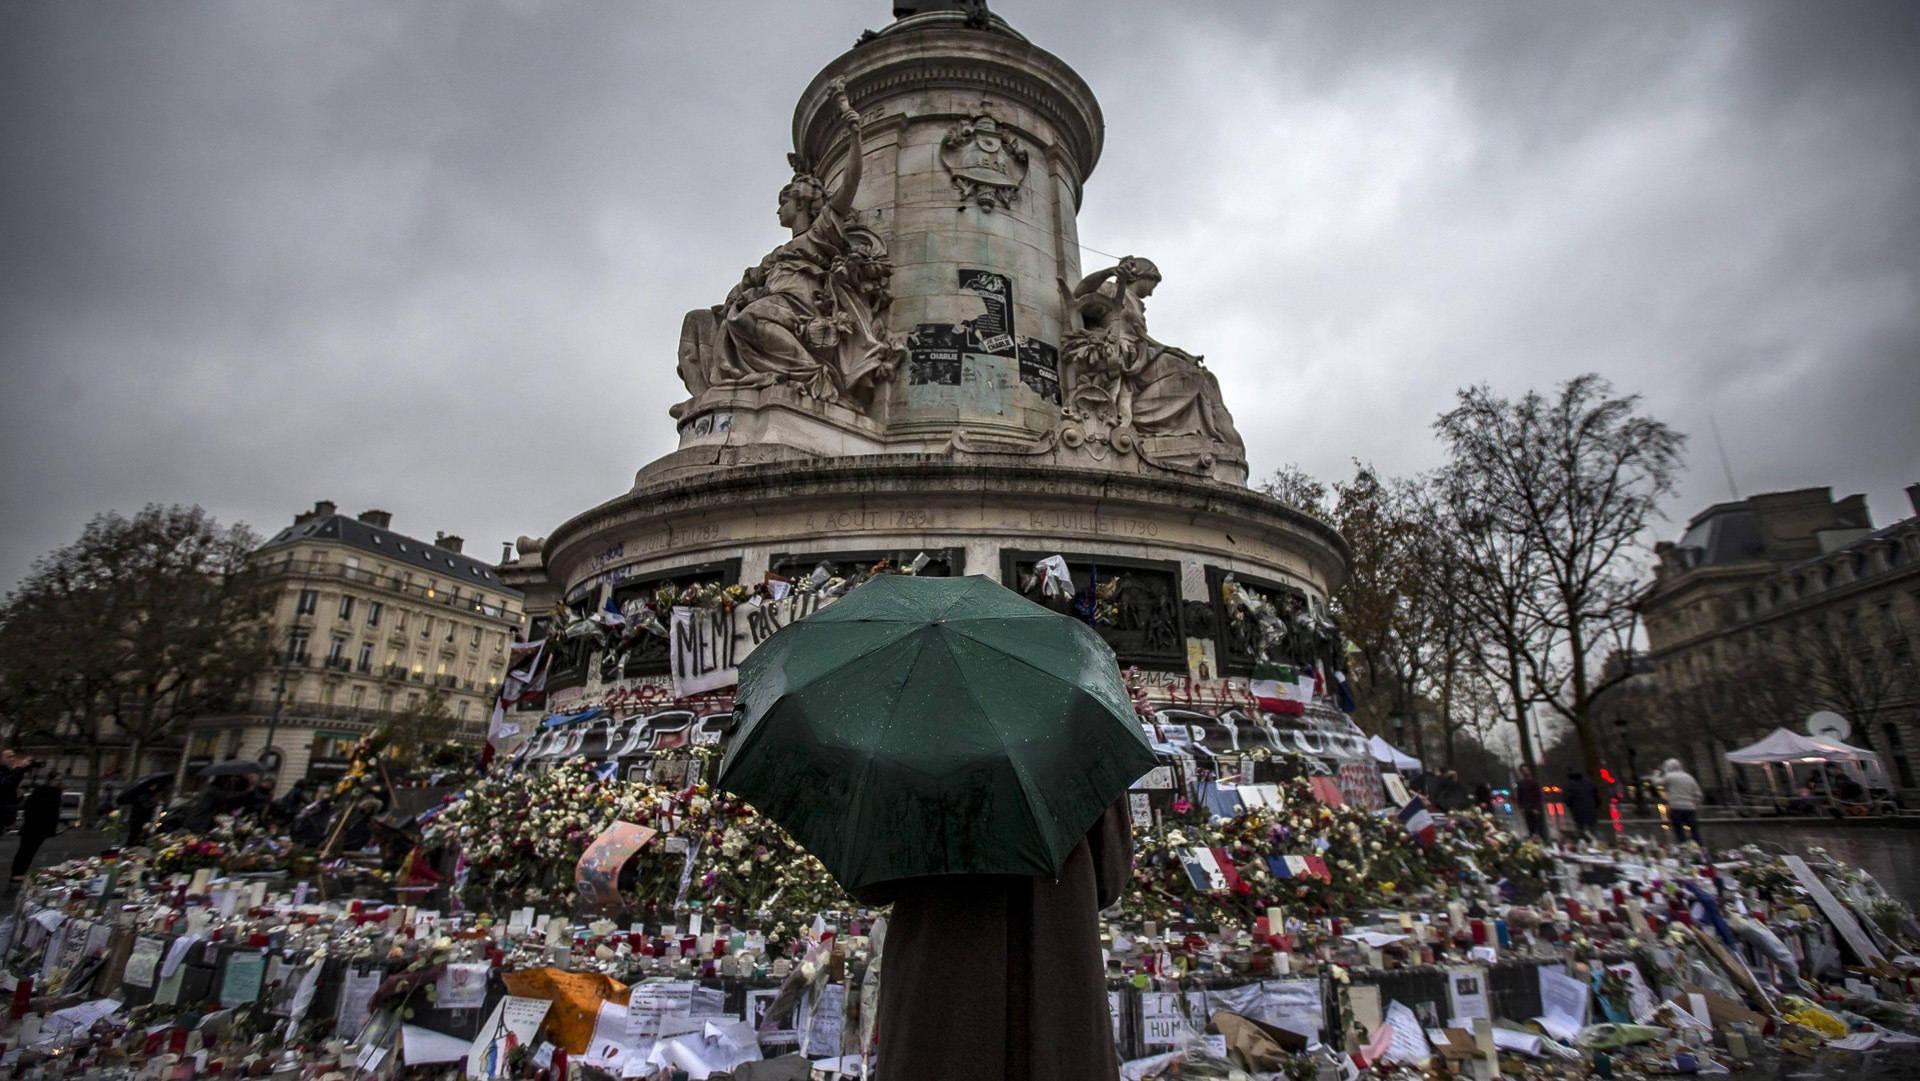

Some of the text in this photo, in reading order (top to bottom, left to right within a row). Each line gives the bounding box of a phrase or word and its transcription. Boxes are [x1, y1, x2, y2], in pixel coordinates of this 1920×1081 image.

[805, 515, 814, 528] 4
[888, 510, 926, 525] 1789
[1029, 512, 1158, 537] 14 JUILLET 1790
[641, 527, 688, 552] JUILLET
[691, 525, 719, 543] 1789
[748, 603, 781, 645] PAS
[1158, 996, 1163, 1013] I
